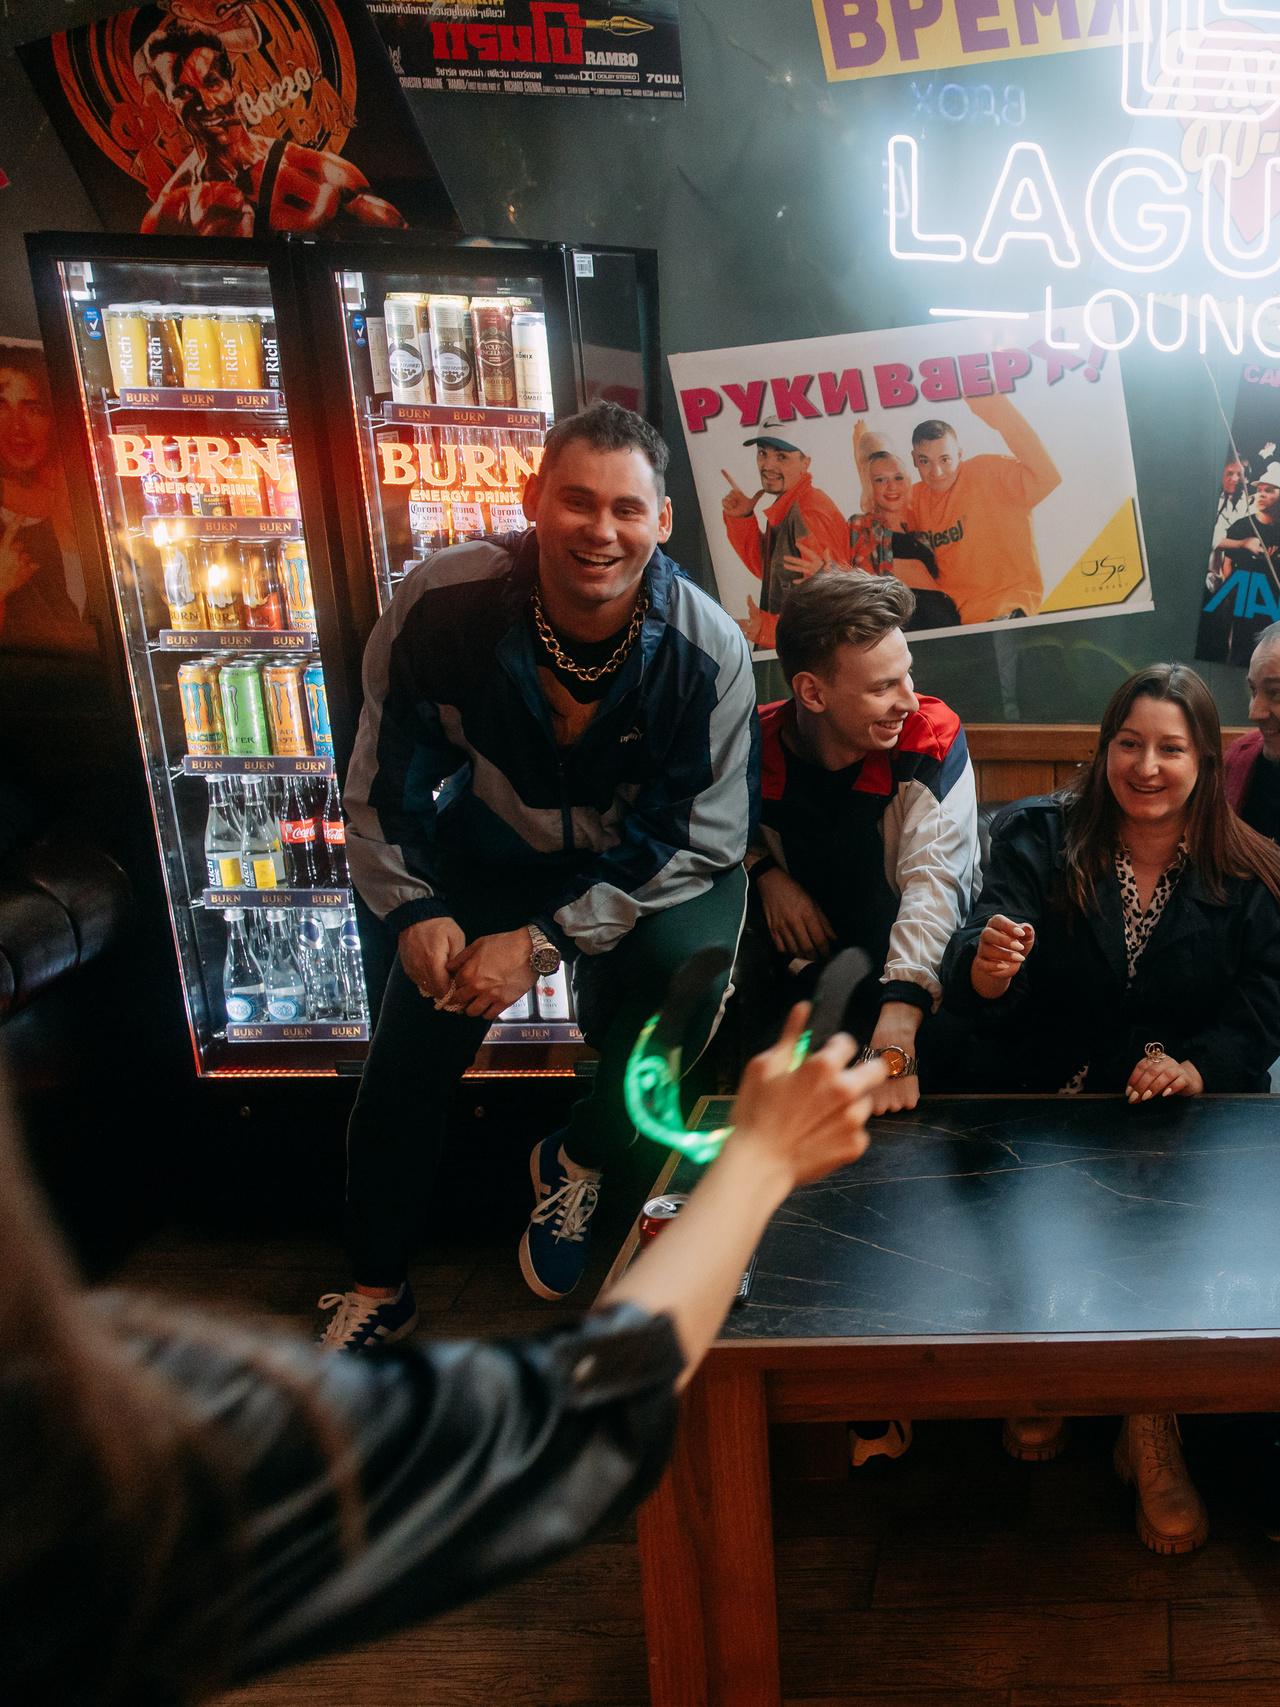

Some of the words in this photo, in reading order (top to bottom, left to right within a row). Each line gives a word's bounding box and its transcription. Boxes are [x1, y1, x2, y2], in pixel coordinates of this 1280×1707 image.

[585, 51, 638, 67] RAMBO
[118, 336, 134, 371] Rich
[149, 336, 163, 371] Rich
[188, 338, 200, 372] Rich
[226, 338, 239, 372] Rich
[264, 339, 280, 373] Rich
[125, 392, 159, 403] BURN
[181, 394, 215, 404] BURN
[236, 395, 269, 405] BURN
[679, 368, 868, 434] РУКИ
[398, 408, 430, 419] BURN
[453, 411, 486, 422] BURN
[507, 414, 539, 424] BURN
[108, 434, 281, 480] BURN
[377, 442, 545, 487] BURN
[144, 482, 205, 494] ENERGY
[210, 483, 257, 496] DRINK
[410, 489, 470, 502] ENERGY
[474, 490, 520, 503] DRINK
[410, 504, 444, 515] Corona
[491, 507, 522, 516] Corona
[205, 521, 238, 531] BURN
[259, 522, 292, 532] BURN
[166, 635, 198, 645] BURN
[220, 636, 252, 645] BURN
[272, 636, 305, 646] BURN
[191, 760, 223, 769] BURN
[244, 761, 275, 770] BURN
[295, 761, 326, 771] BURN
[206, 859, 217, 886] Rich
[242, 861, 252, 887] Rich
[210, 894, 241, 903] BURN
[261, 894, 292, 903] BURN
[311, 894, 342, 904] BURN
[232, 1027, 263, 1036] BURN
[283, 1027, 313, 1036] BURN
[331, 1026, 361, 1035] BURN
[487, 1029, 502, 1038] RN
[521, 1028, 550, 1037] BURN
[569, 1029, 583, 1037] BU
